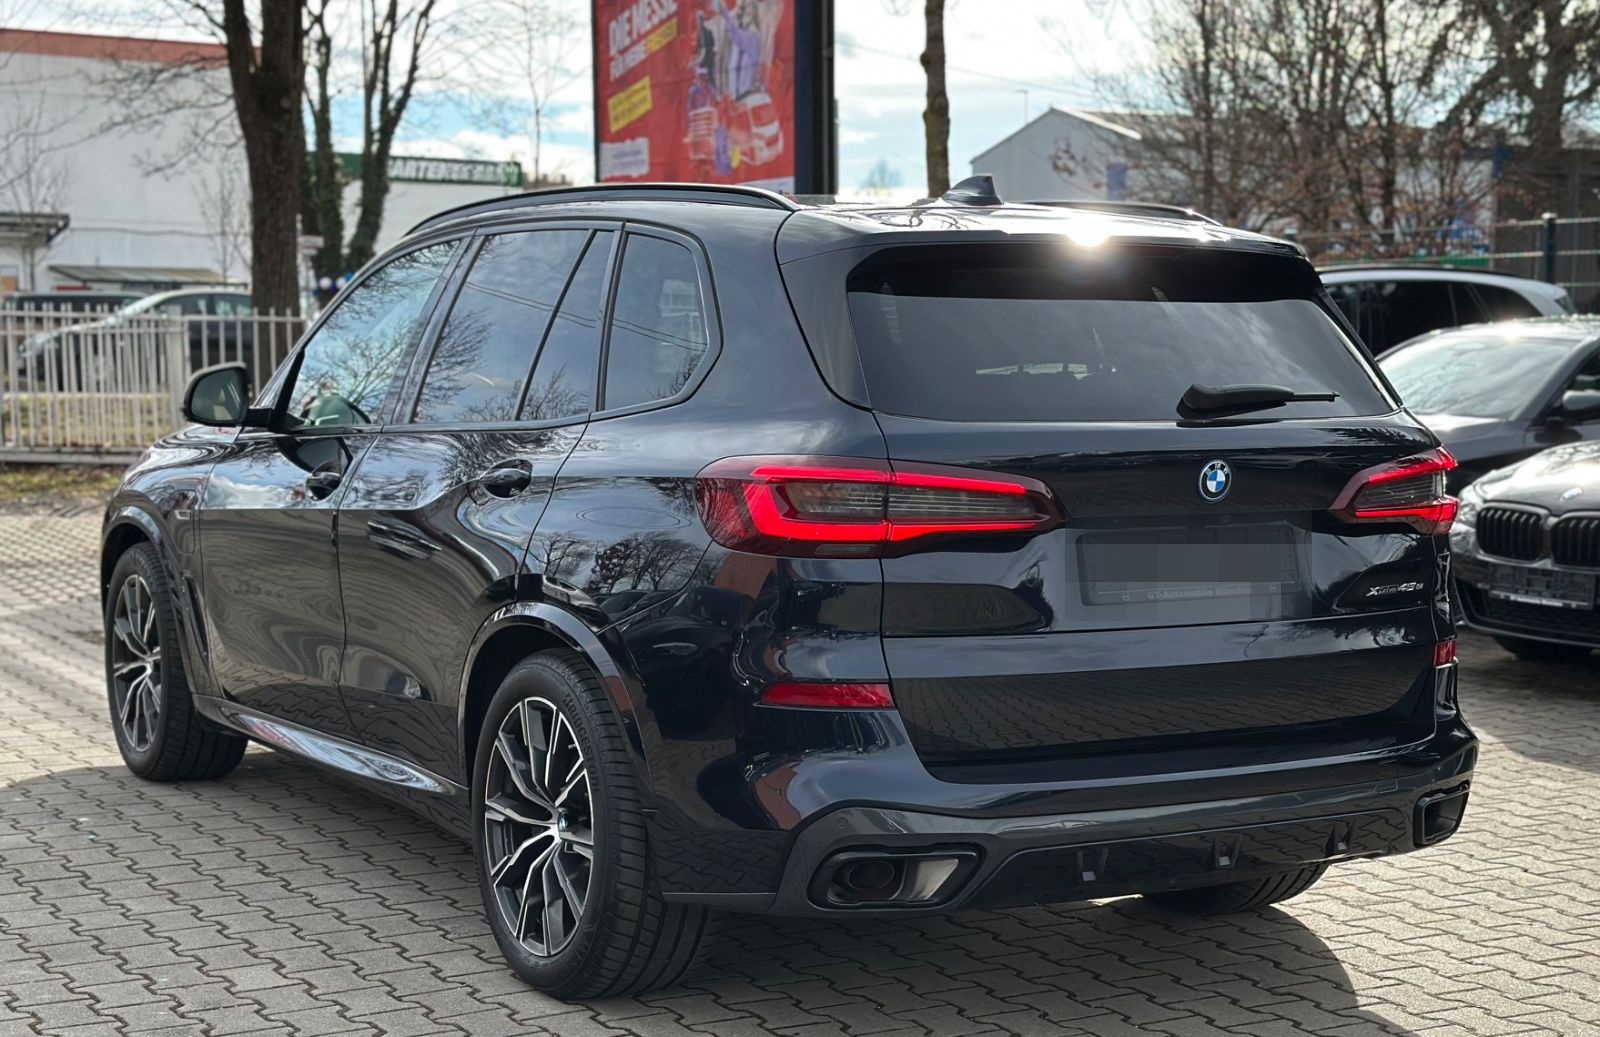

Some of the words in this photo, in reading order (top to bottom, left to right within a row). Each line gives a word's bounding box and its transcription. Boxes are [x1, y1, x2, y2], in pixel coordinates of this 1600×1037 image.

[609, 9, 631, 56] DIE
[1147, 589, 1213, 600] GT-Automobile
[1215, 583, 1253, 596] München
